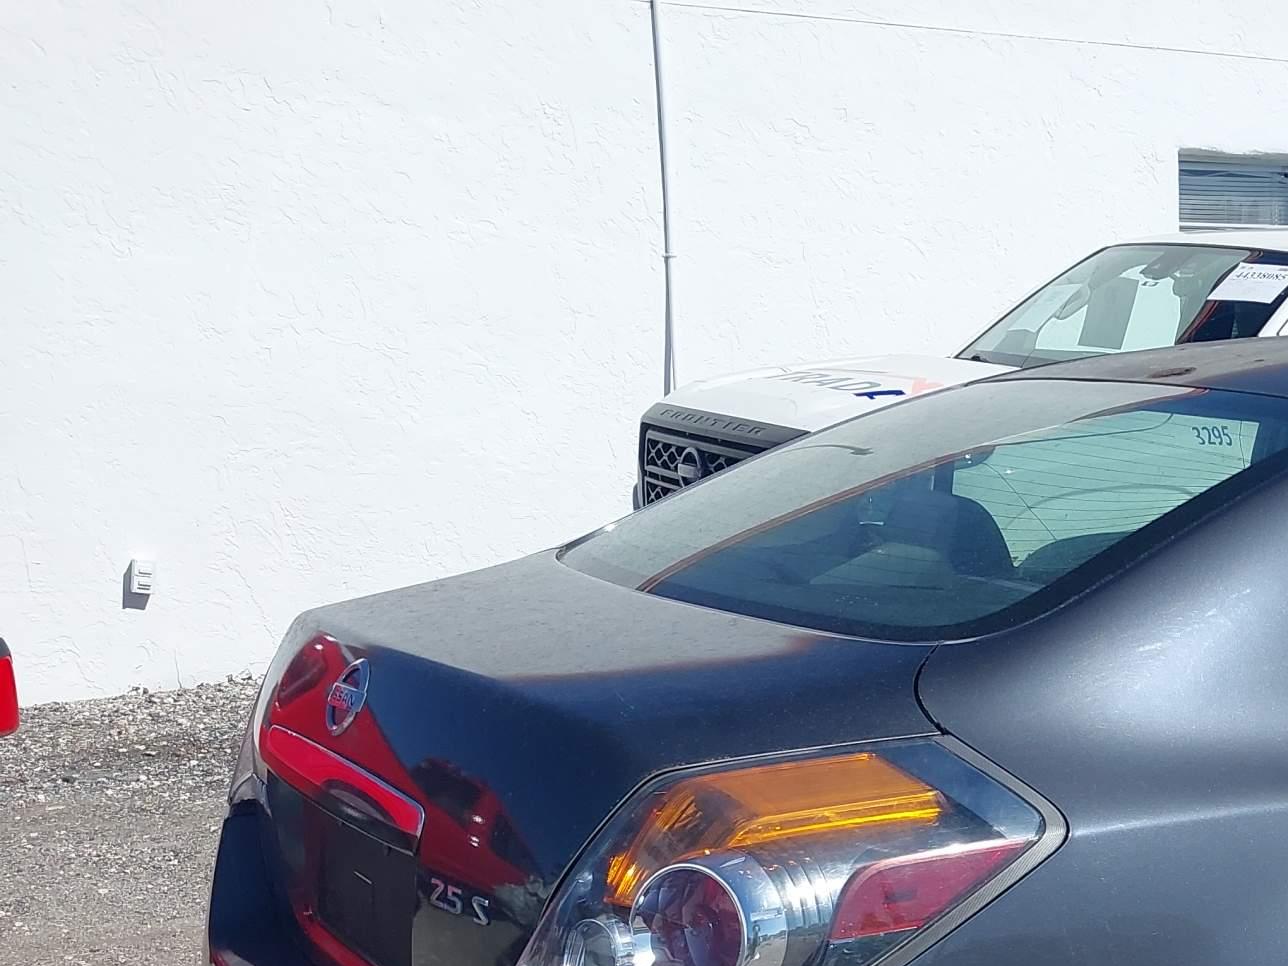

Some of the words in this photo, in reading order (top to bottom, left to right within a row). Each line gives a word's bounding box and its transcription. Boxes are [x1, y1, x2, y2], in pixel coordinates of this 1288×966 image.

[660, 409, 766, 435] FRONTIER
[1191, 425, 1232, 446] 3295
[471, 896, 489, 925] S
